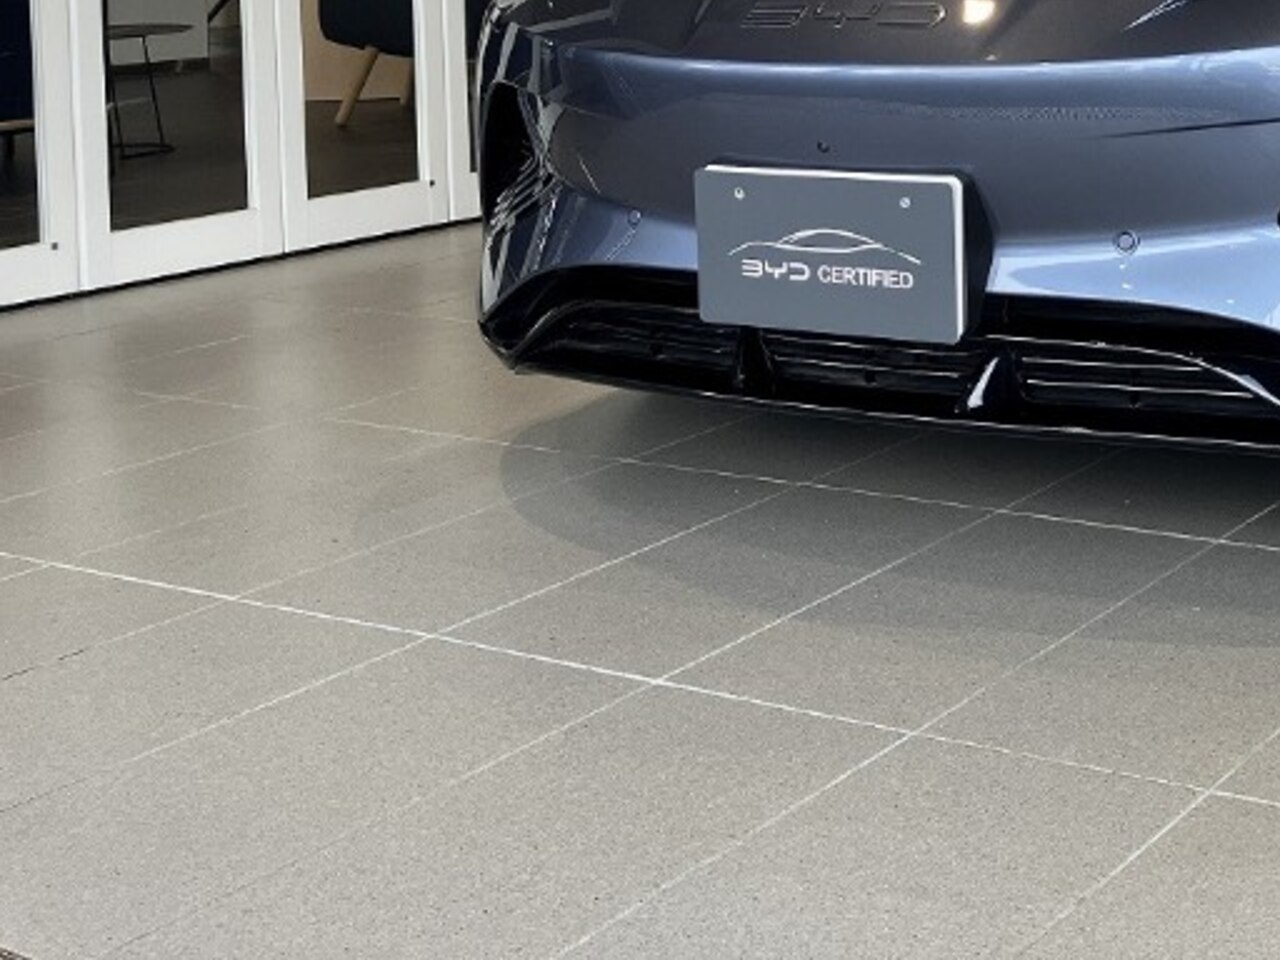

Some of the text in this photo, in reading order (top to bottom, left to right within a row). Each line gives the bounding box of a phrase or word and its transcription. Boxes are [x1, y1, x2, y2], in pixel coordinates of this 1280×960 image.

[740, 1, 948, 29] BYD
[741, 259, 914, 289] BYD CERTIFIED
